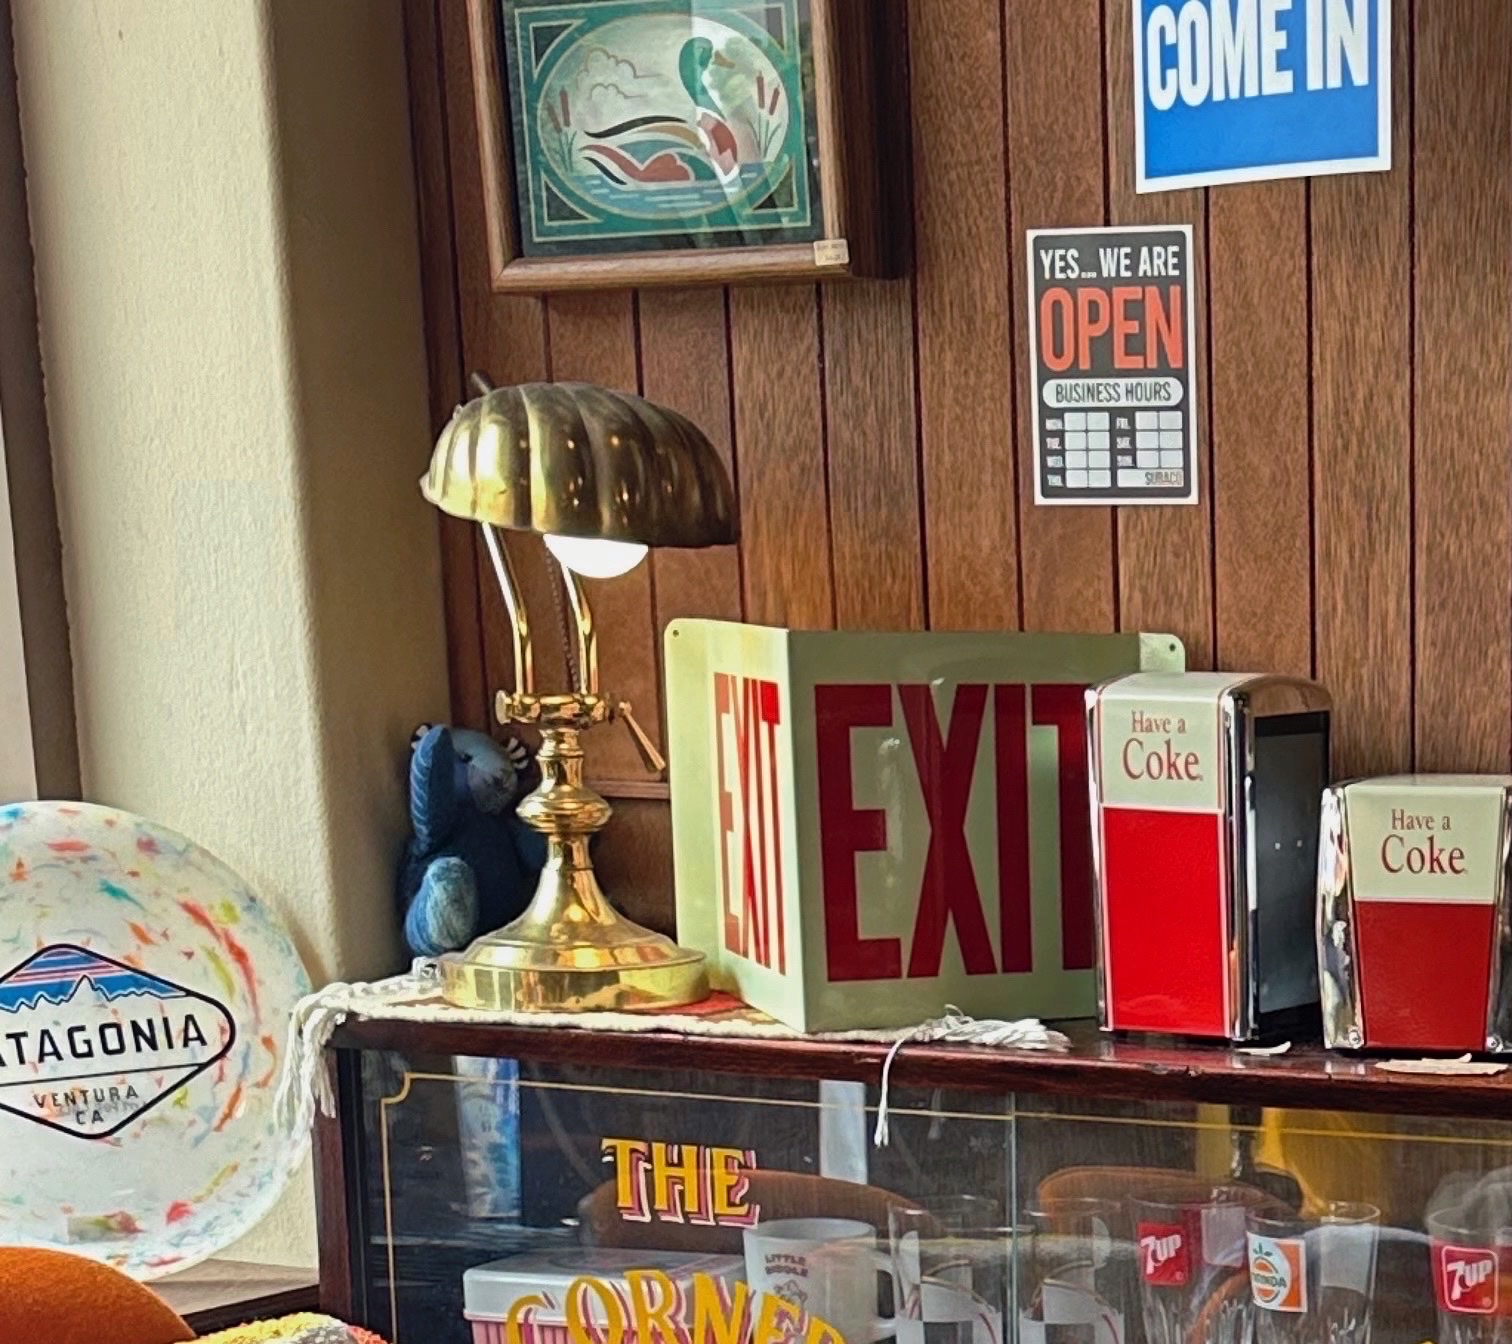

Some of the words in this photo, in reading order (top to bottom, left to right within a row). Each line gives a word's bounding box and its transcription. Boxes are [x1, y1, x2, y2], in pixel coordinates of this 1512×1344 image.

[1146, 0, 1294, 110] COME
[1305, 0, 1369, 91] IN
[1134, 247, 1180, 277] ARE
[1040, 284, 1184, 371] OPEN
[1055, 382, 1121, 403] BUSINESS
[1125, 381, 1171, 402] HOURS
[1131, 710, 1171, 735] Have
[1176, 717, 1187, 734] a
[1122, 737, 1199, 782] Coke
[713, 669, 788, 975] EXIT
[814, 682, 1091, 984] EXIT
[1391, 807, 1434, 832] Have
[1439, 817, 1450, 832] a
[1380, 834, 1465, 876] Coke
[32, 1085, 139, 1109] VENTURA
[76, 1109, 104, 1125] CA
[601, 1137, 758, 1228] THE
